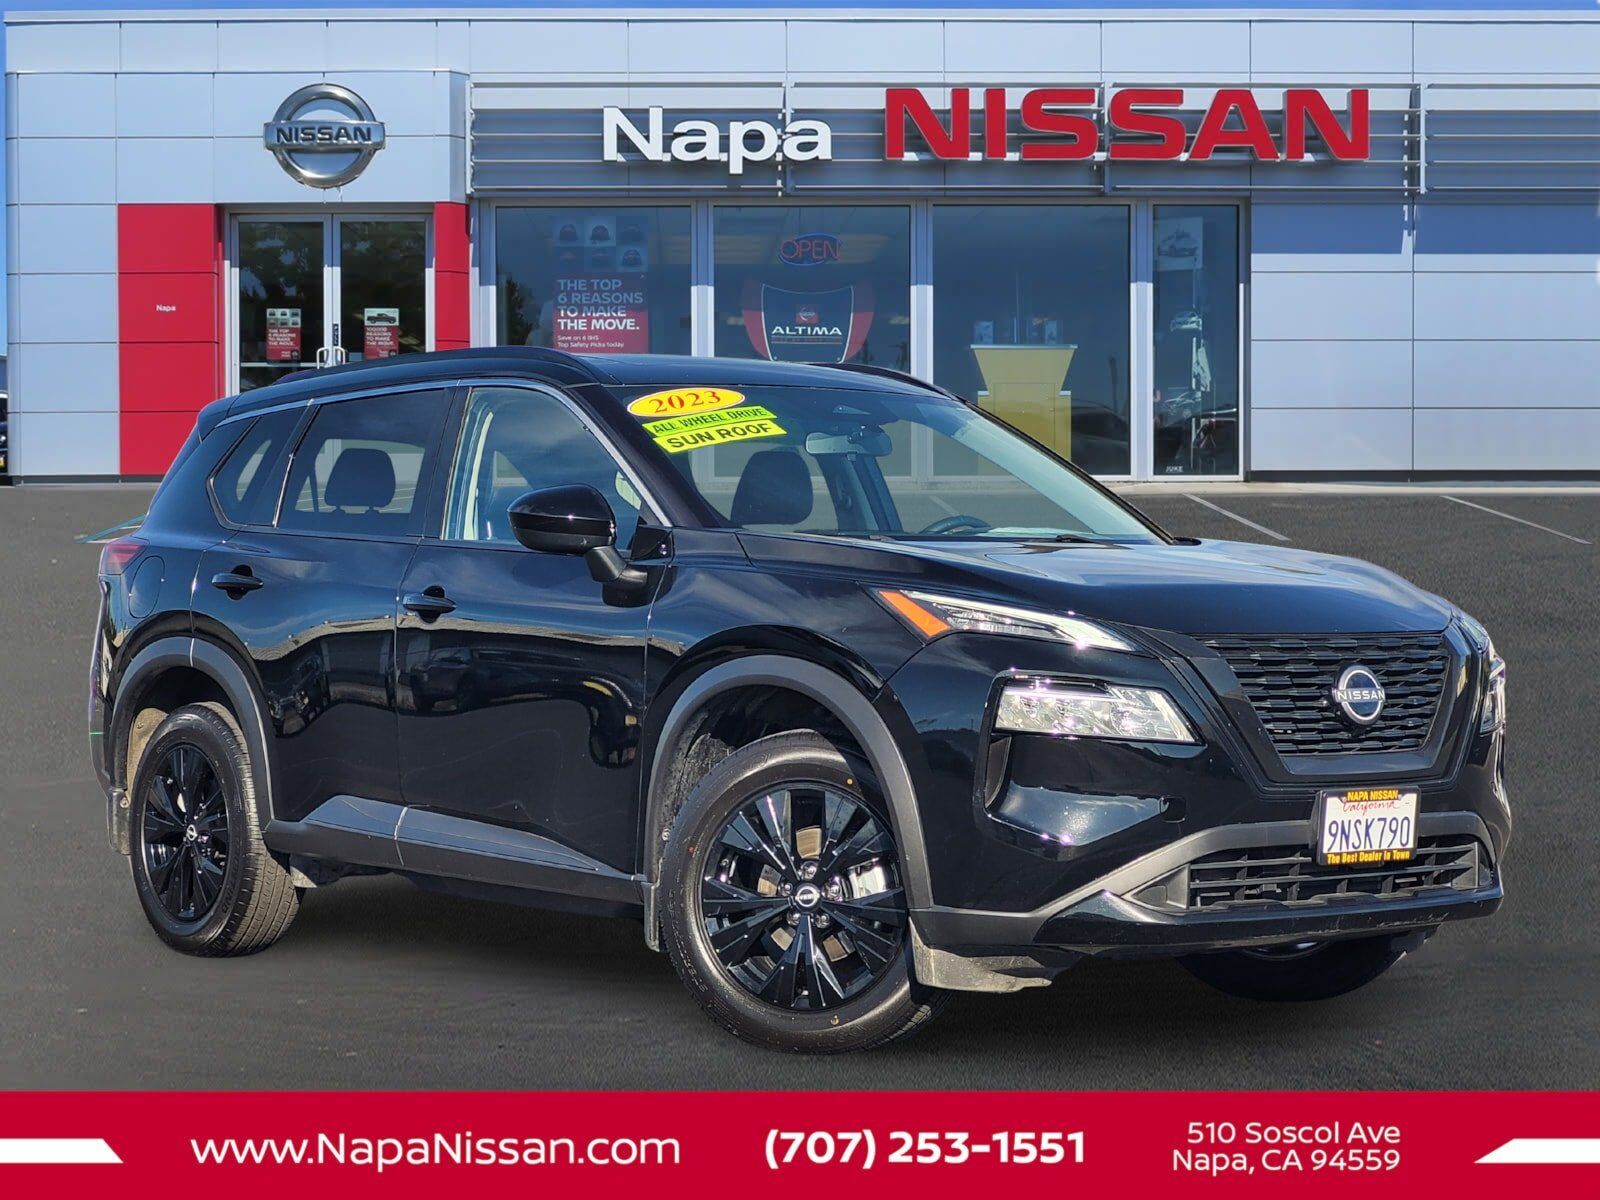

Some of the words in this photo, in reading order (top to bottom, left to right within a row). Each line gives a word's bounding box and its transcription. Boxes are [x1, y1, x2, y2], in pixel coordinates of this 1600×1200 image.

[276, 126, 372, 143] NISSAN
[602, 106, 833, 175] Napa
[884, 87, 1370, 161] NISSAN
[781, 239, 841, 260] OPEN
[557, 279, 587, 291] THE
[591, 279, 622, 291] TOP
[558, 292, 568, 304] 6
[572, 292, 644, 304] REASONS
[156, 304, 177, 312] Napa
[557, 306, 578, 317] TO
[582, 306, 627, 317] MAKE
[557, 319, 587, 330] THE
[591, 319, 640, 330] MOVE.
[771, 326, 843, 335] ALTIMA
[649, 391, 721, 414] 2023
[653, 420, 678, 434] ALL
[680, 414, 724, 428] WHEEL
[727, 408, 768, 419] DRIVE
[666, 430, 715, 448] SUN
[717, 423, 773, 439] ROOF
[1336, 690, 1385, 701] NISSAN
[1347, 791, 1368, 801] NAPA
[1369, 790, 1399, 800] NISSAN
[1327, 816, 1411, 852] 9NSK790
[1327, 853, 1341, 864] The
[1342, 852, 1357, 863] Best
[1359, 851, 1382, 862] Dealer
[1383, 850, 1391, 860] in
[1392, 849, 1410, 860] Town
